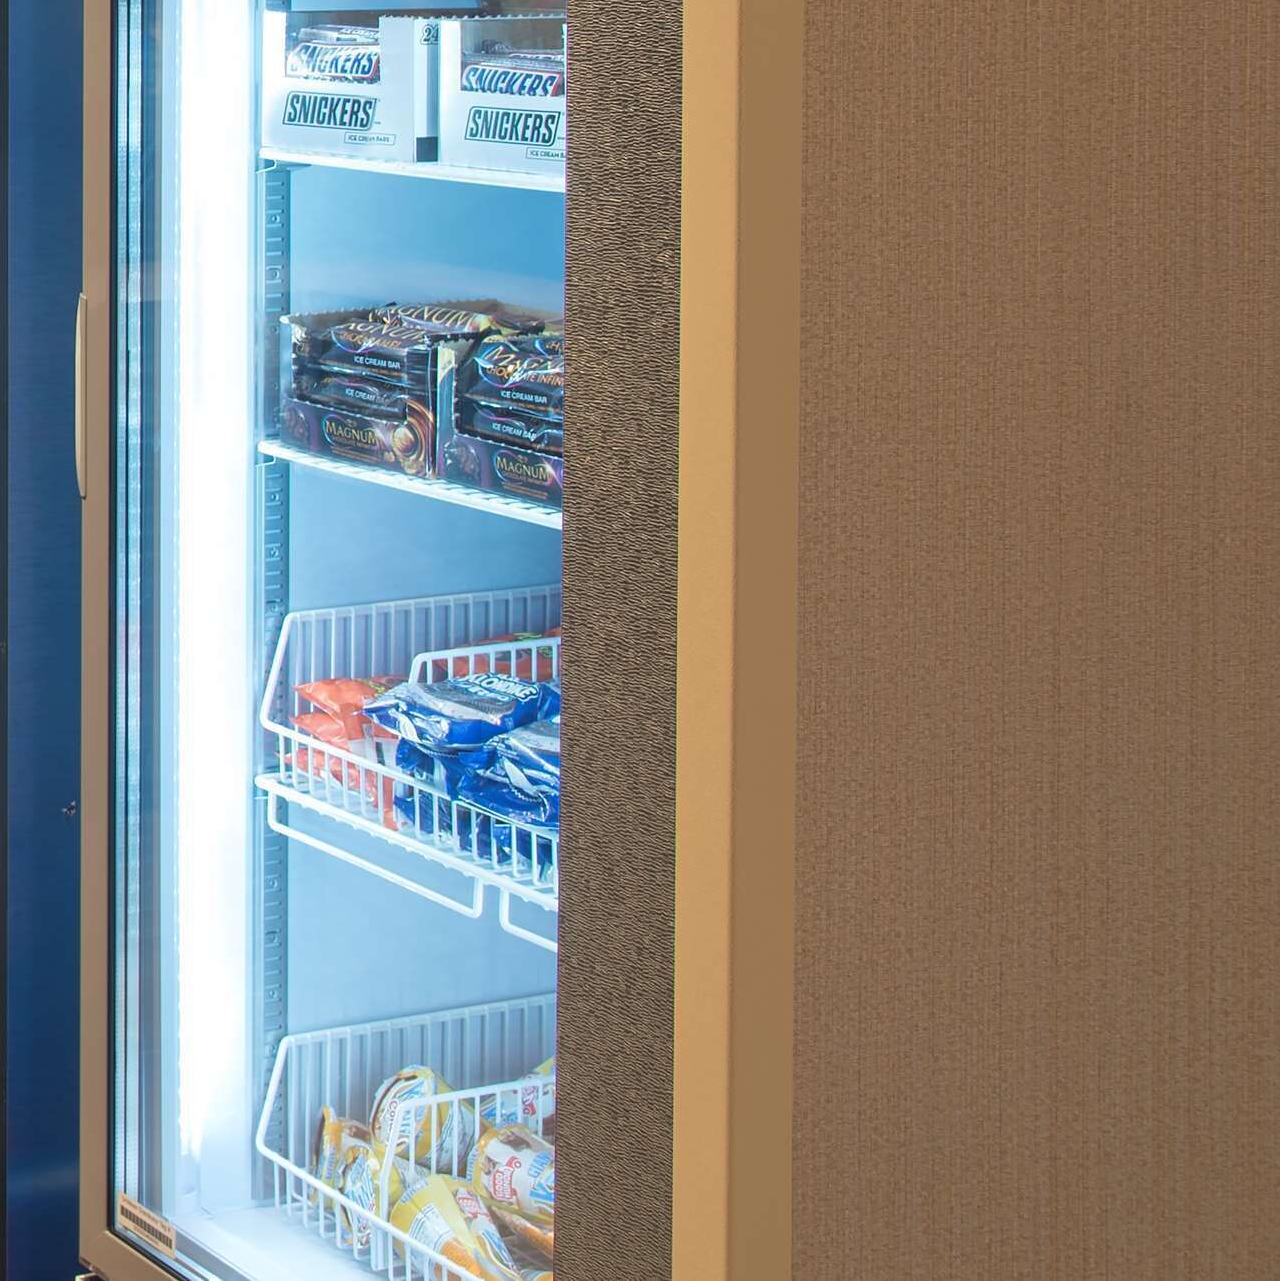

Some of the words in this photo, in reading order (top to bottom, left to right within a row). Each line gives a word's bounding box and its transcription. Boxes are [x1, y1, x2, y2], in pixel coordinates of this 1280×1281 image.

[463, 66, 558, 97] SNICKERS
[288, 93, 373, 129] SNICKERS
[469, 109, 556, 144] SNICKERS
[540, 151, 560, 159] CREAM
[353, 355, 364, 364] ICE
[365, 357, 387, 367] CREAM
[387, 361, 401, 369] BAR
[345, 389, 355, 397] ICE
[355, 390, 376, 401] CREAM
[501, 390, 511, 399] ICE
[512, 391, 534, 403] CREAM
[534, 395, 547, 404] BAR
[325, 419, 376, 445] MAGNUM
[491, 422, 500, 431] ICE
[501, 424, 523, 436] CREAM
[496, 456, 548, 480] MAGNUM
